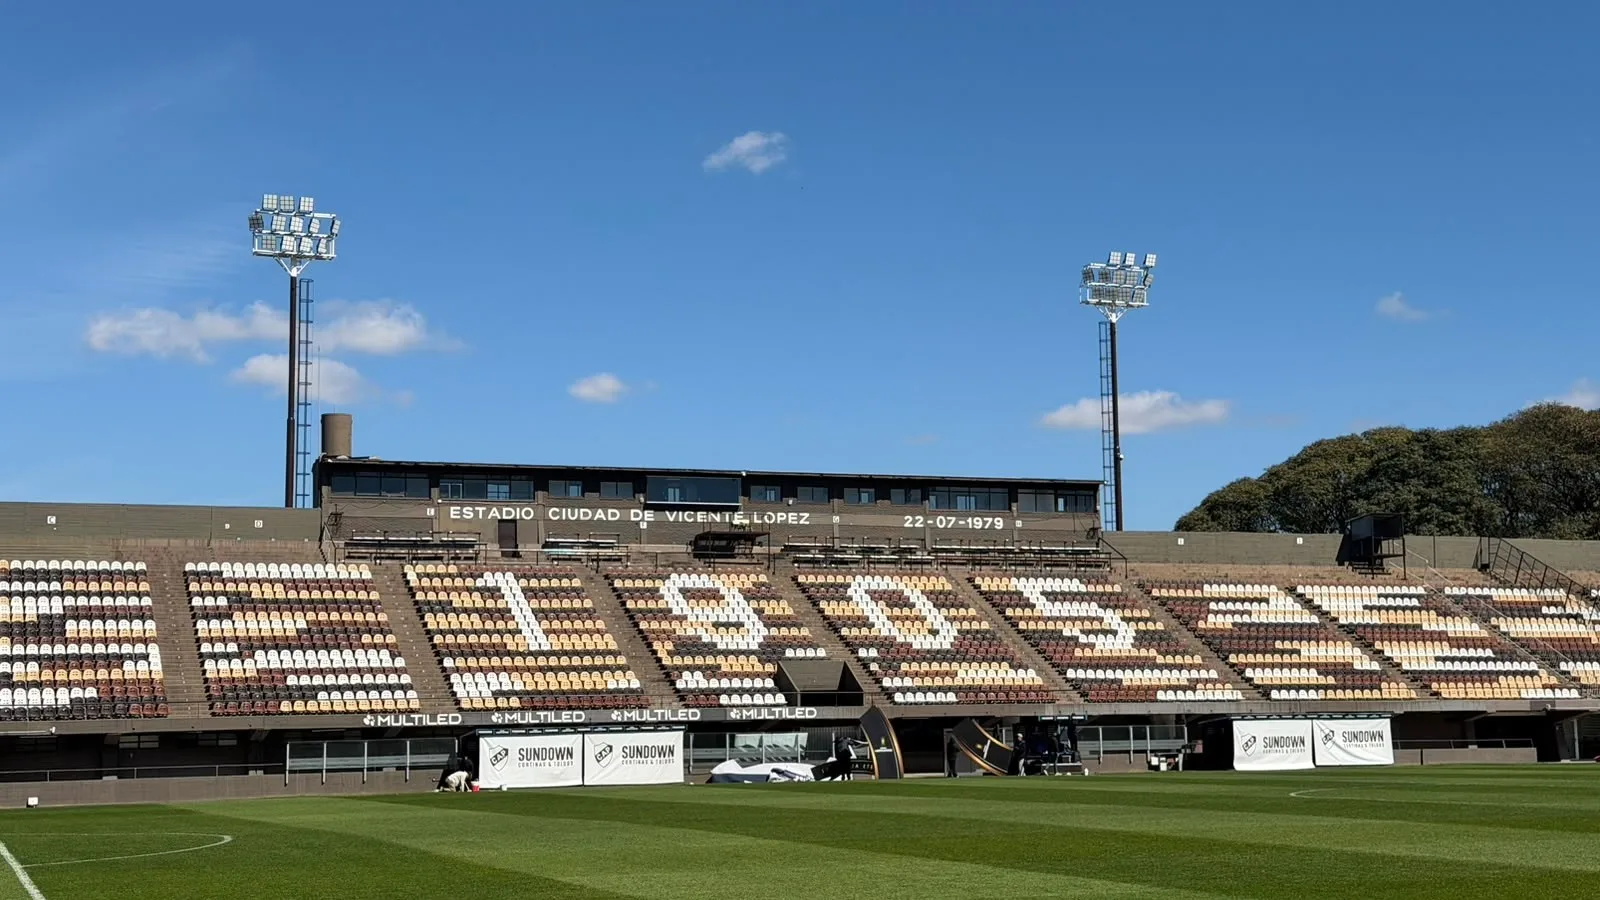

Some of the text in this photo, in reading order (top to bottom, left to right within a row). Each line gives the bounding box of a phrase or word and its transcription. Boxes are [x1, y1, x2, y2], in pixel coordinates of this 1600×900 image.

[48, 516, 56, 524] C
[450, 506, 810, 525] ESTADIO CIUDAD DE VICENTE LOPEZ
[255, 520, 263, 528] D
[904, 515, 1004, 530] 22-07-1979
[505, 711, 586, 724] MULTILED
[624, 709, 701, 722] MULTILED
[742, 707, 817, 720] MULTILED
[378, 714, 462, 727] MULTILED
[1263, 736, 1306, 749] SUNDOWN
[1342, 730, 1384, 743] SUNDOWN
[518, 746, 574, 762] SUNDOWN
[622, 744, 675, 759] SUNDOWN
